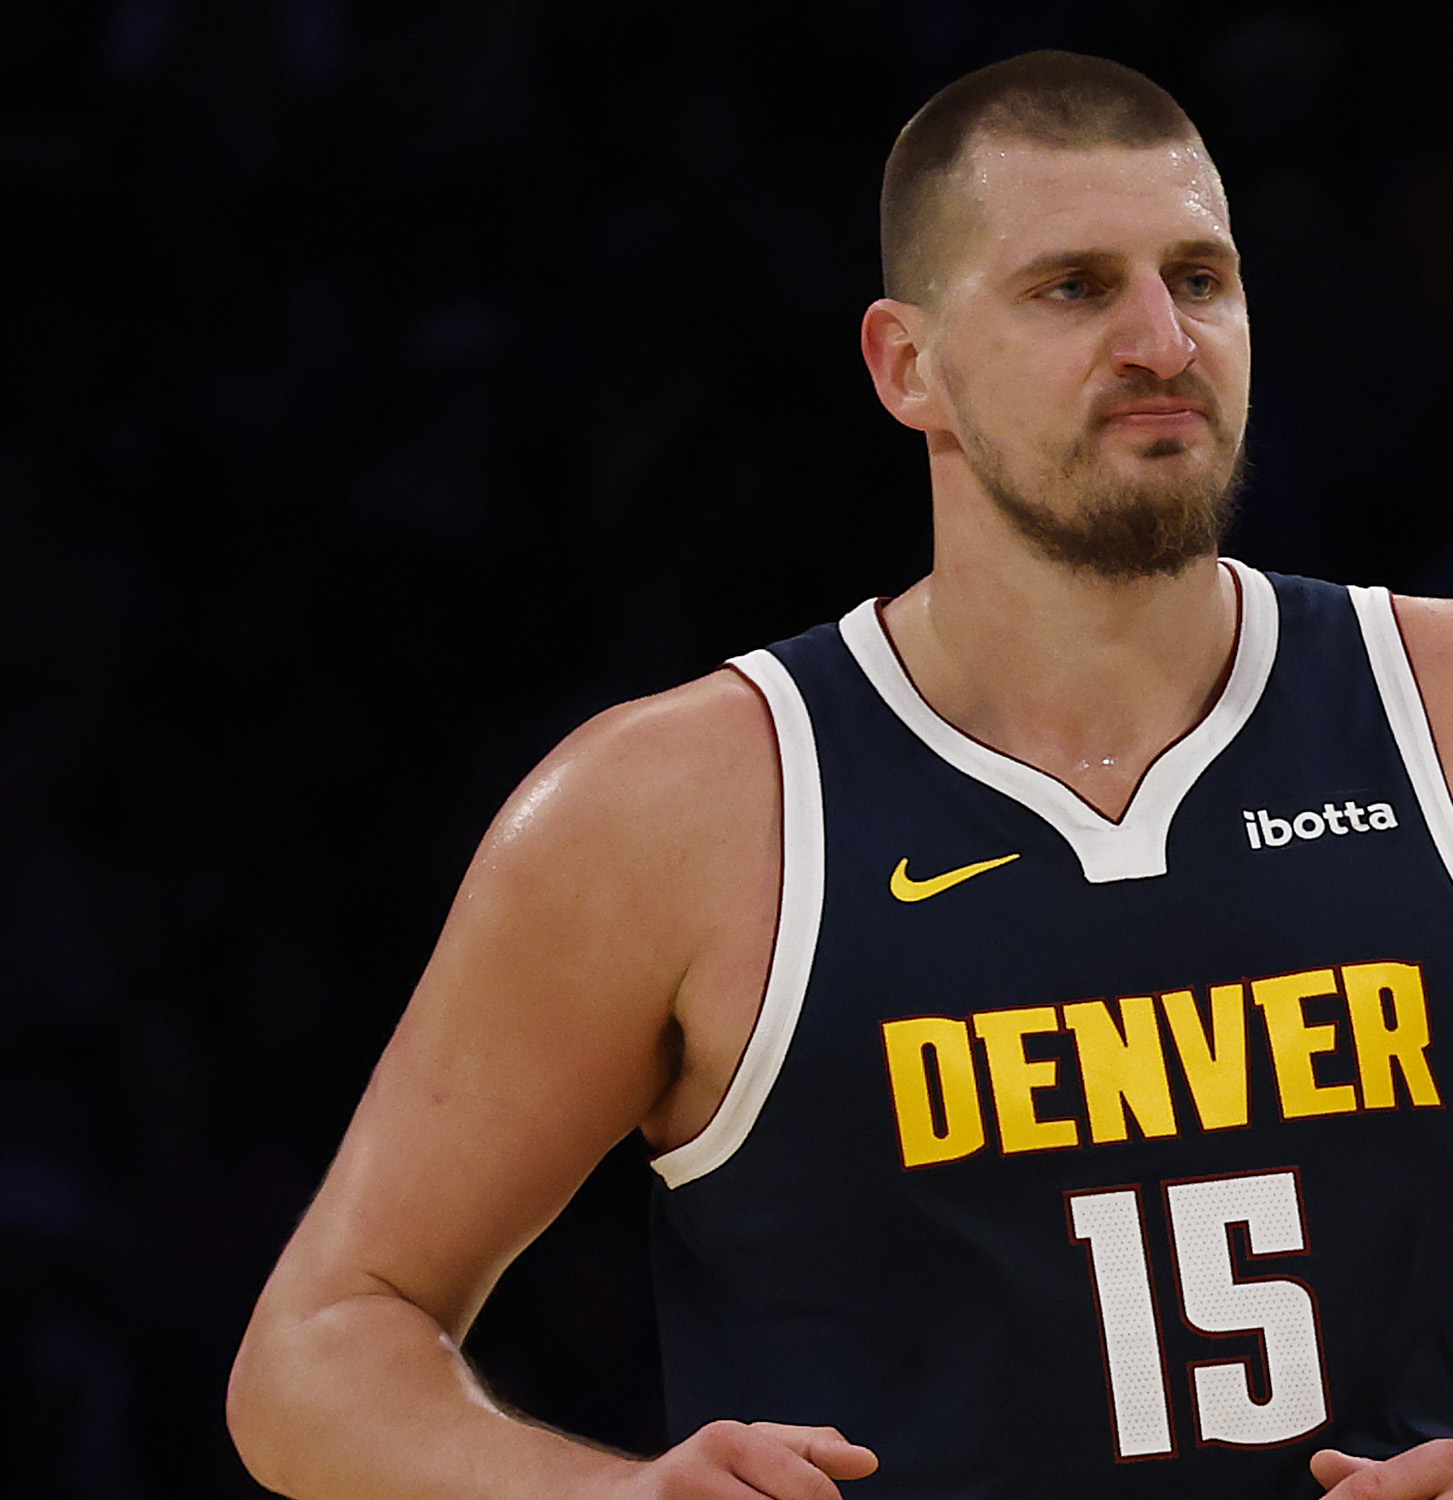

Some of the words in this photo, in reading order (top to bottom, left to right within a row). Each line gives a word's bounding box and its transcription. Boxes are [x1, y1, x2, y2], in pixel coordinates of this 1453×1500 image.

[1242, 799, 1399, 850] ibotta
[880, 958, 1445, 1170] DENVER
[1062, 1166, 1332, 1462] 15
